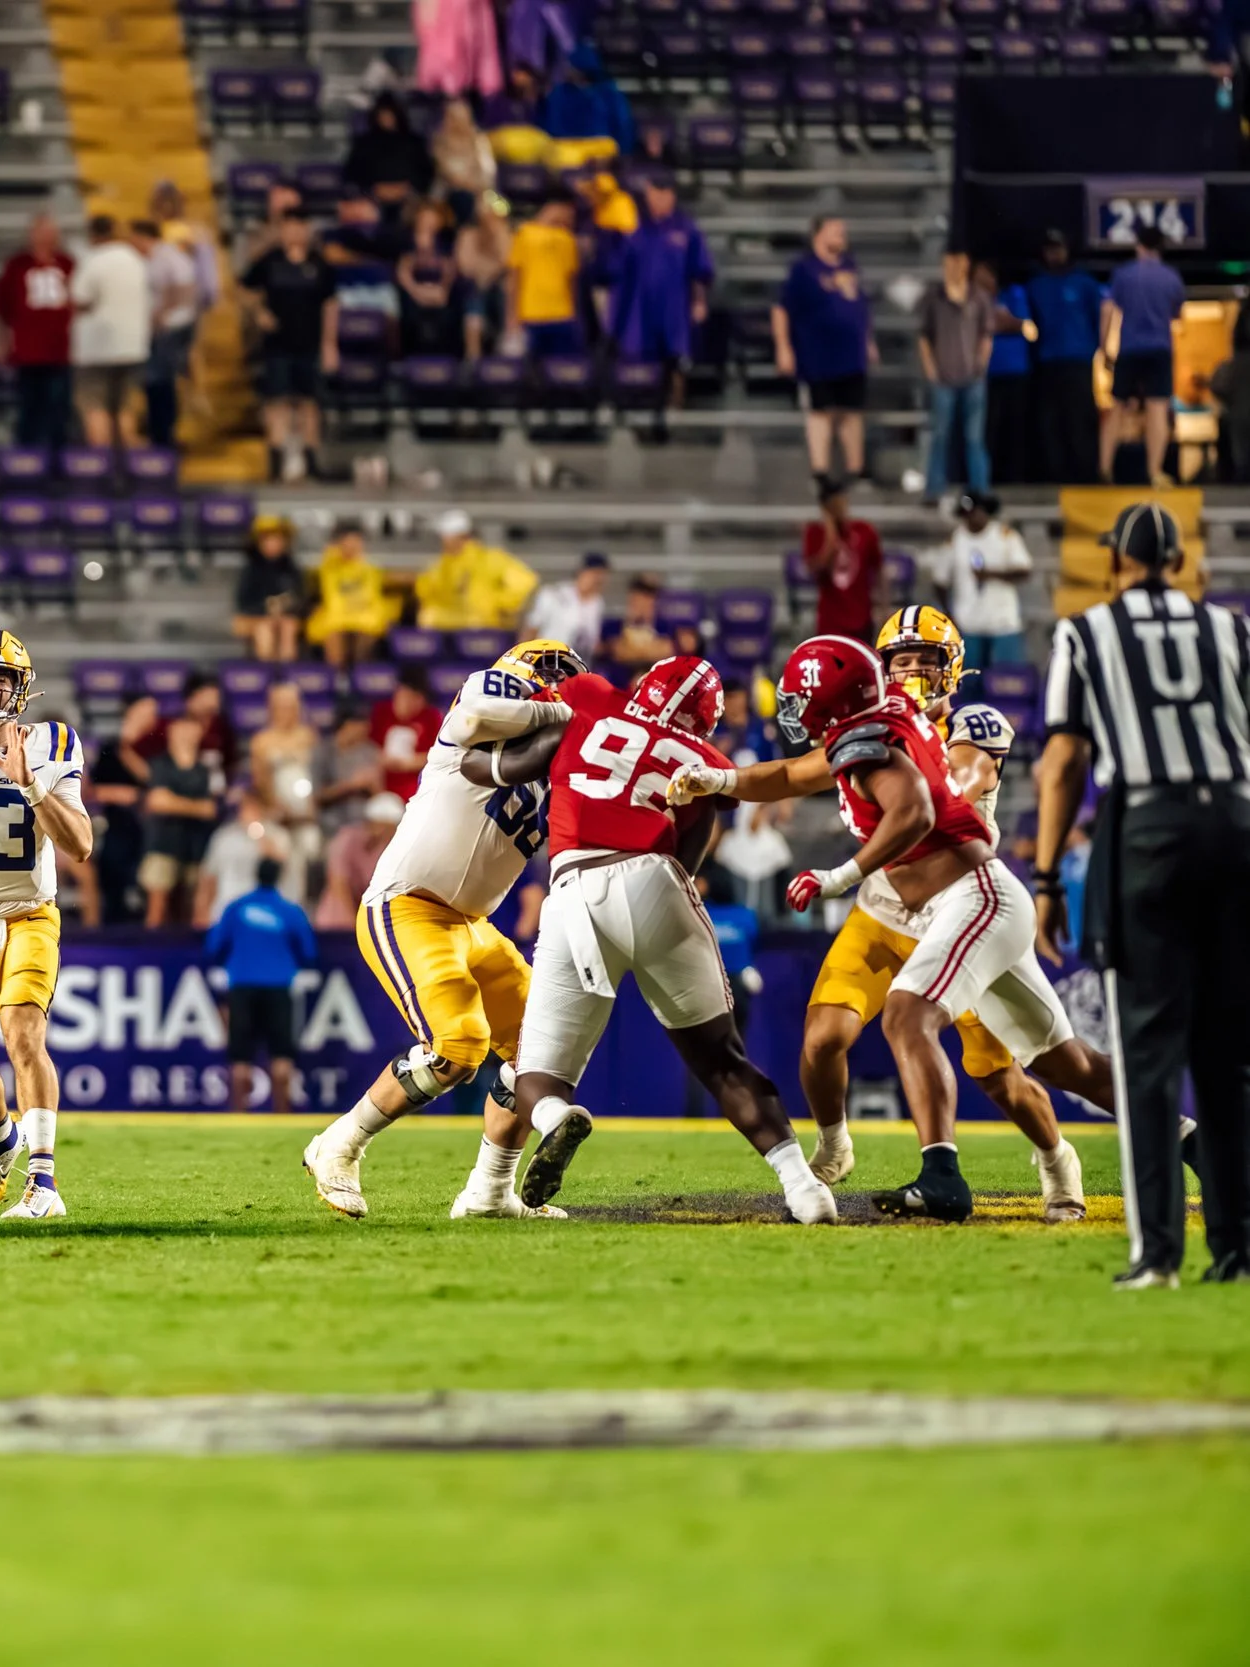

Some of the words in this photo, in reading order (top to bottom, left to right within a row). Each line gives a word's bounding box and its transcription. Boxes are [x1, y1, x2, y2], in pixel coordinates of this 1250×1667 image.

[1108, 198, 1188, 243] 214
[799, 658, 822, 688] 31
[1133, 621, 1202, 701] U
[483, 669, 523, 700] 66
[964, 710, 1002, 741] 86
[569, 716, 706, 822] 92
